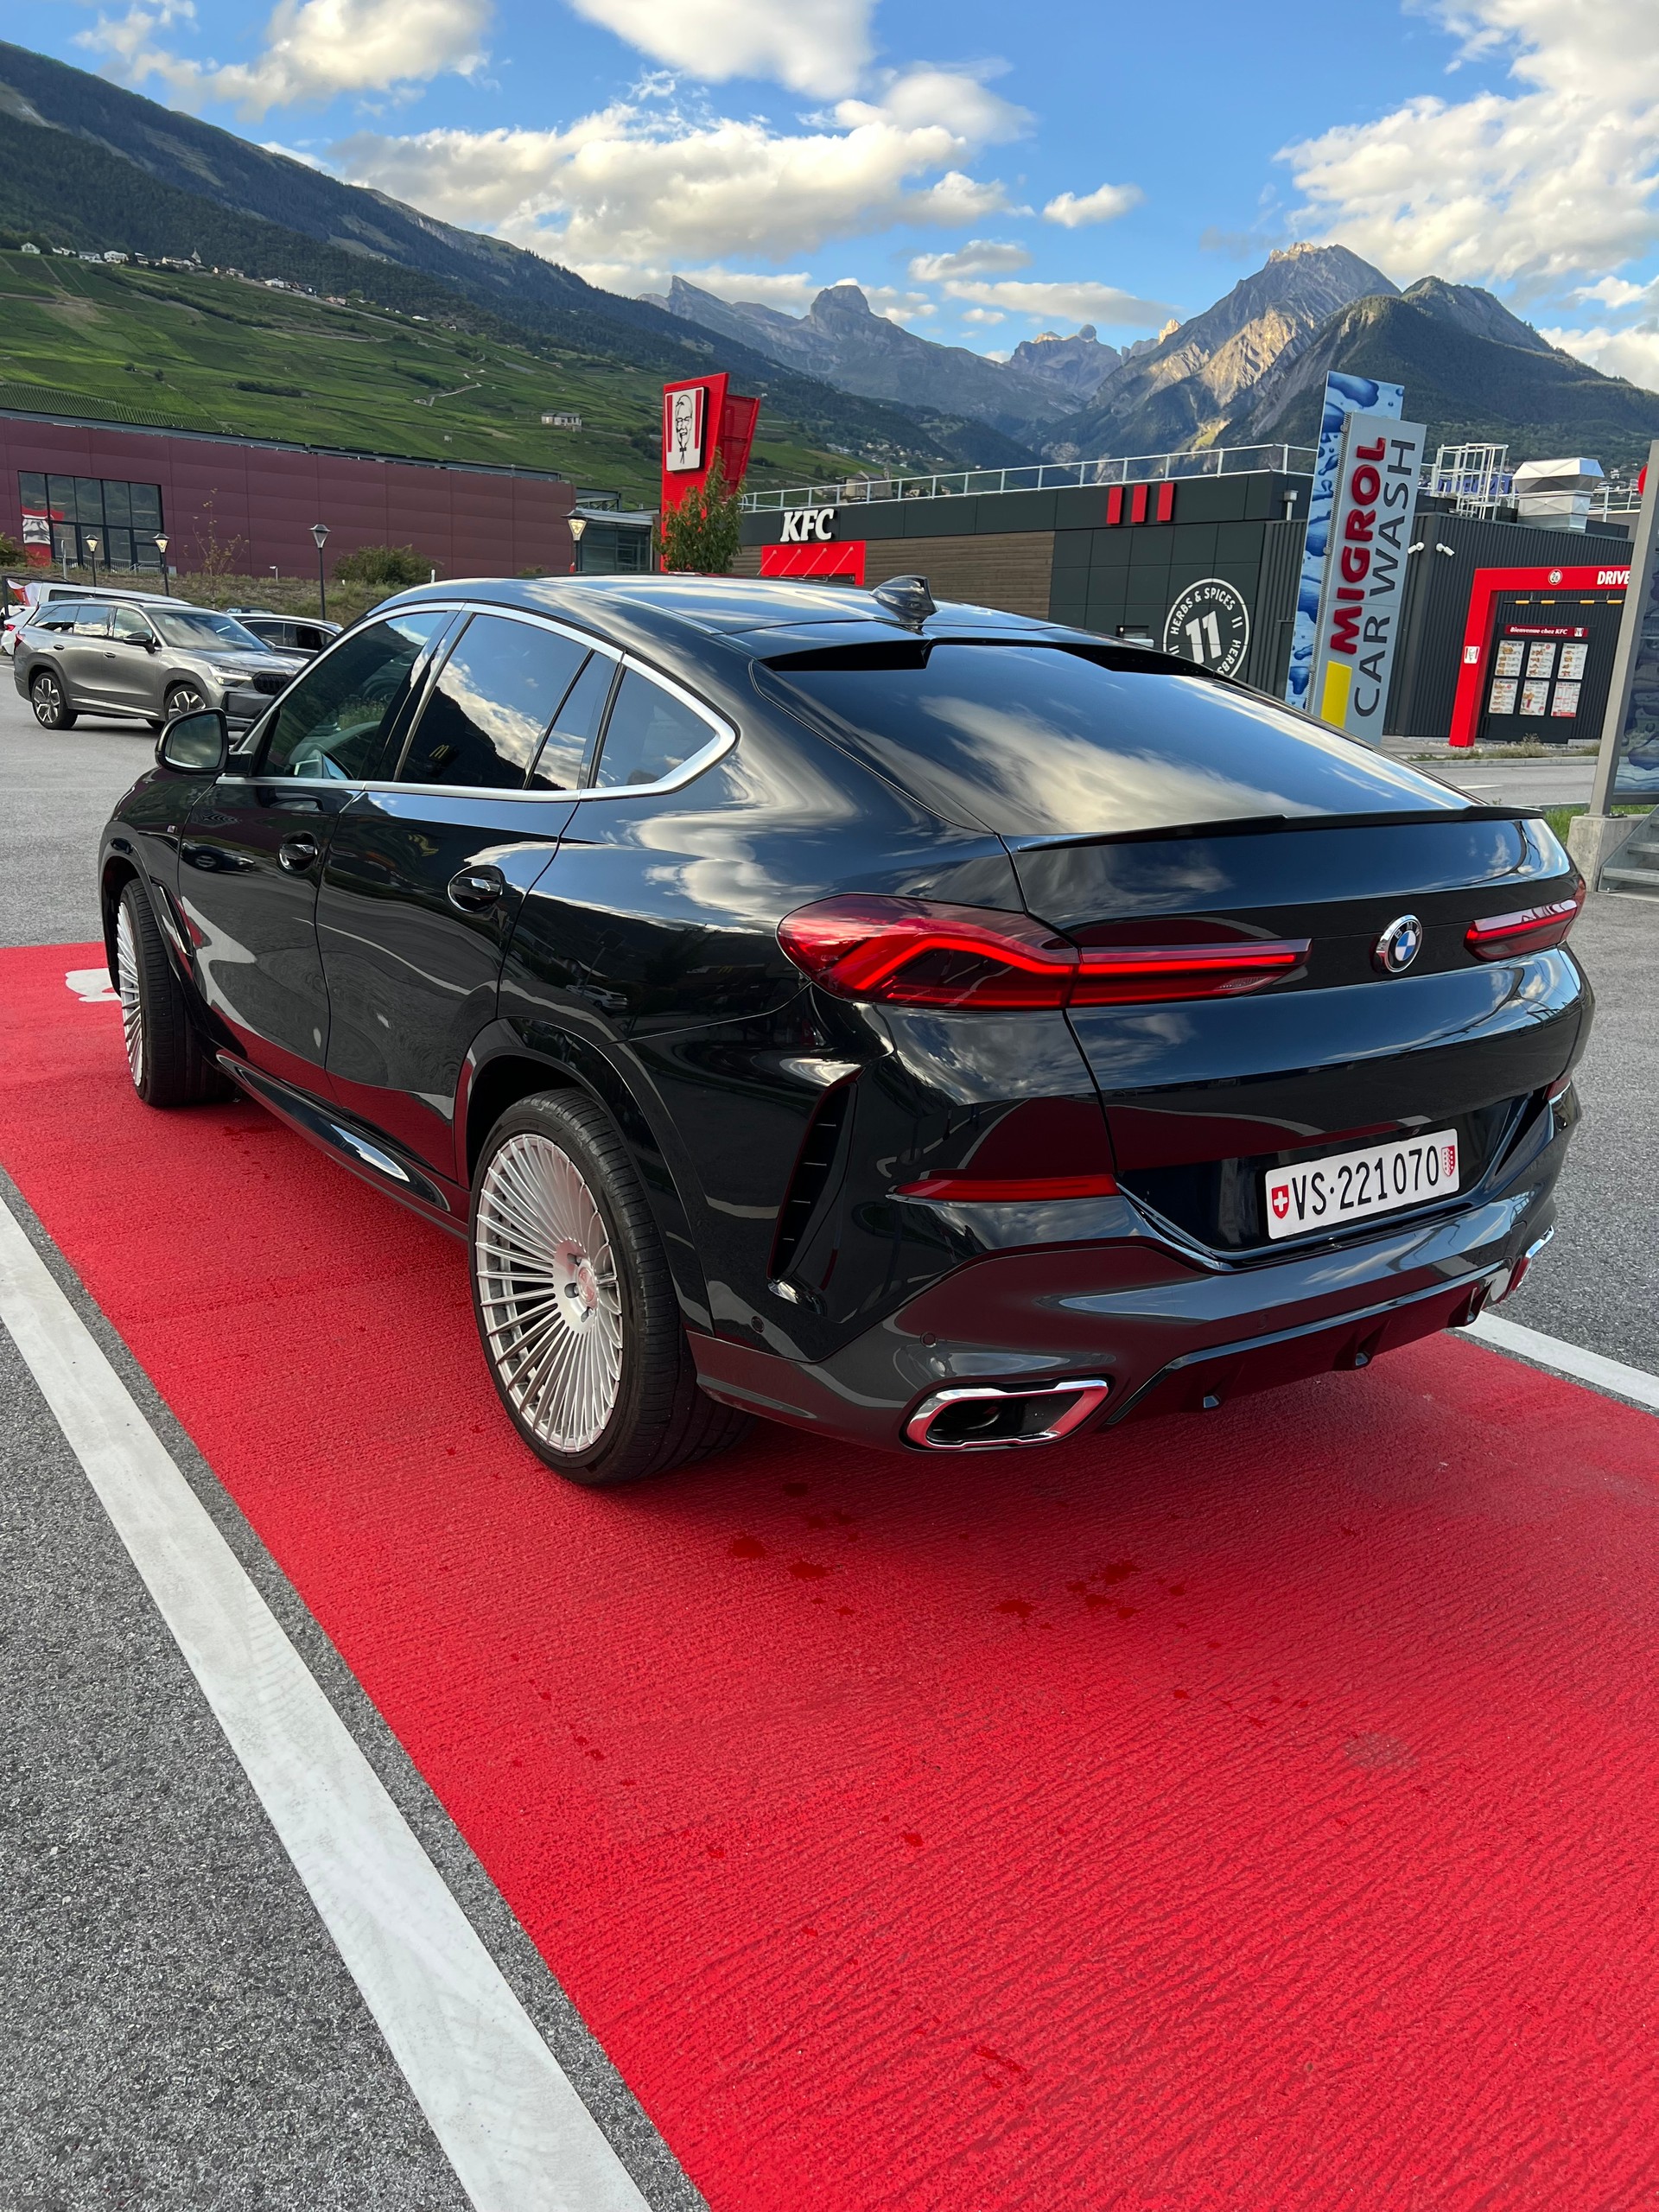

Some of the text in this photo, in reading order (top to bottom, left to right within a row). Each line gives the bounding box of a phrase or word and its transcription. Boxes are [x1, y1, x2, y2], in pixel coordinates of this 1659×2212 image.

[780, 508, 835, 543] KFC
[1330, 436, 1387, 655] MIGROL
[1354, 439, 1416, 717] CAR WASH
[1596, 570, 1630, 585] DRIVE
[1170, 588, 1236, 635] HERBS & SPICES
[1185, 610, 1223, 664] 11
